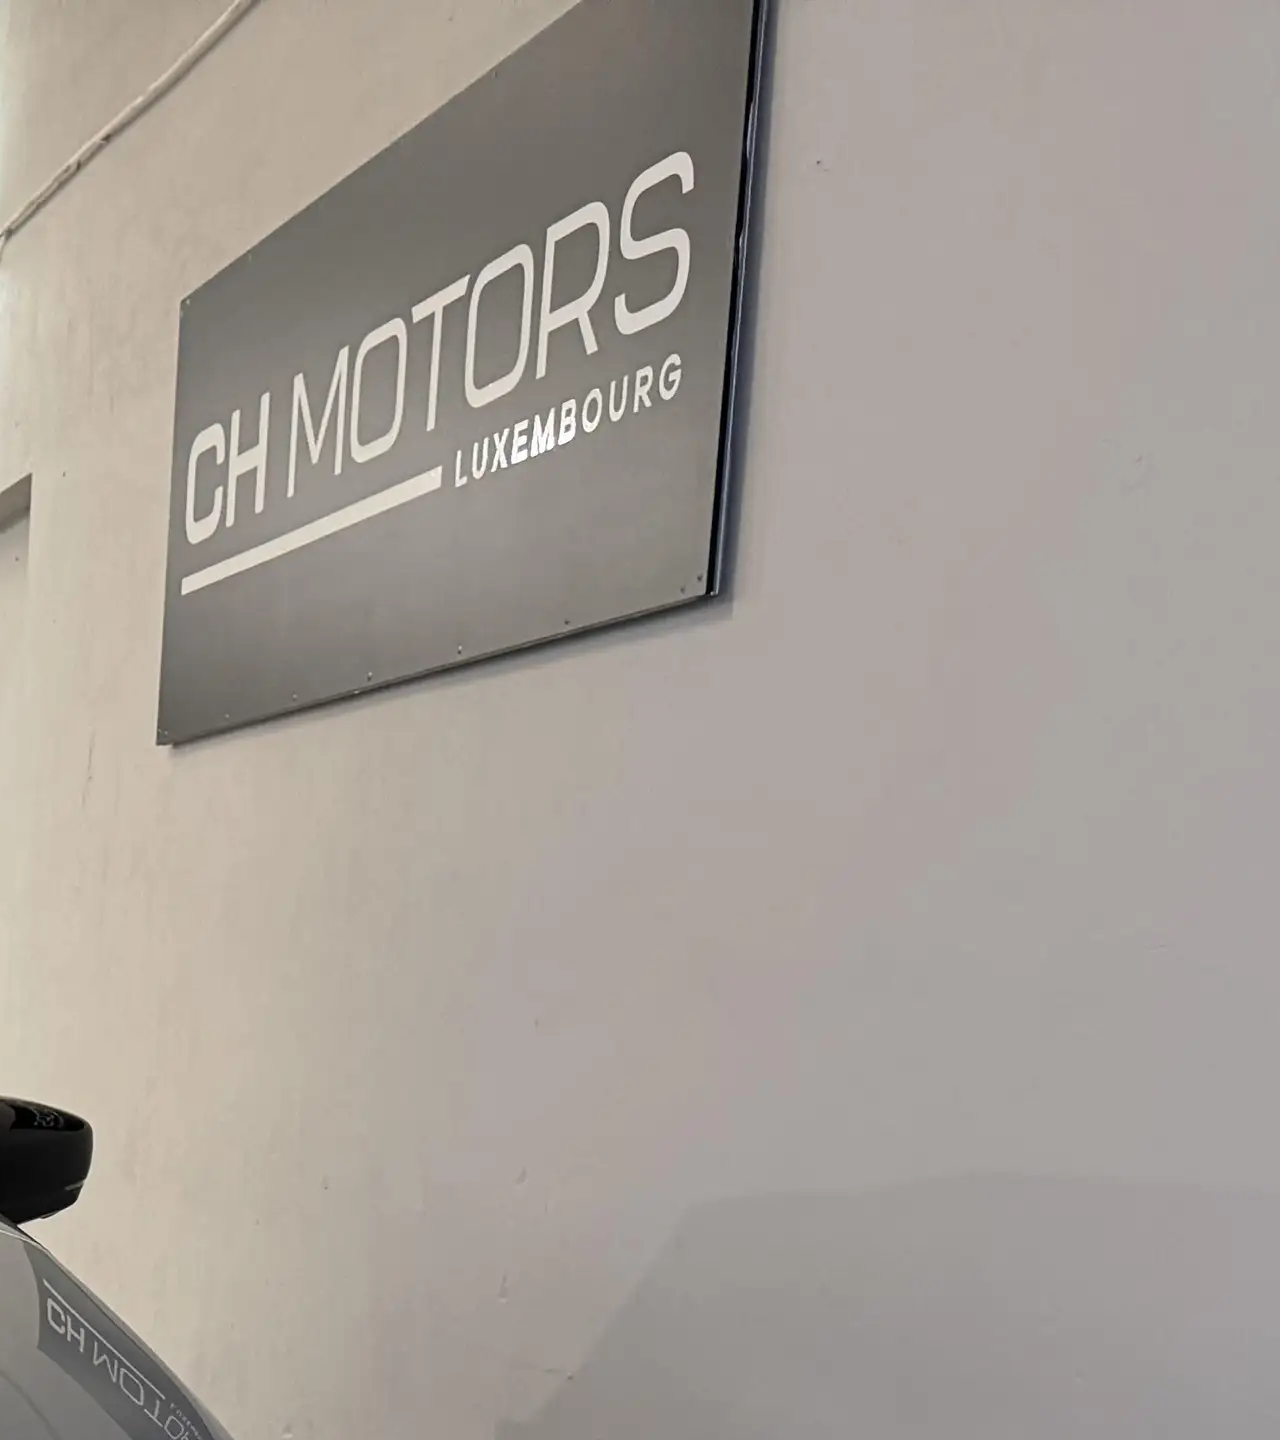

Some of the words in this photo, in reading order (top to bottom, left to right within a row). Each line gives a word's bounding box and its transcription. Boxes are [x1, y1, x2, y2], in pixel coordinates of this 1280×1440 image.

[184, 391, 271, 545] CH
[286, 150, 695, 499] MOTORS
[453, 352, 683, 488] LUXEMBOURG
